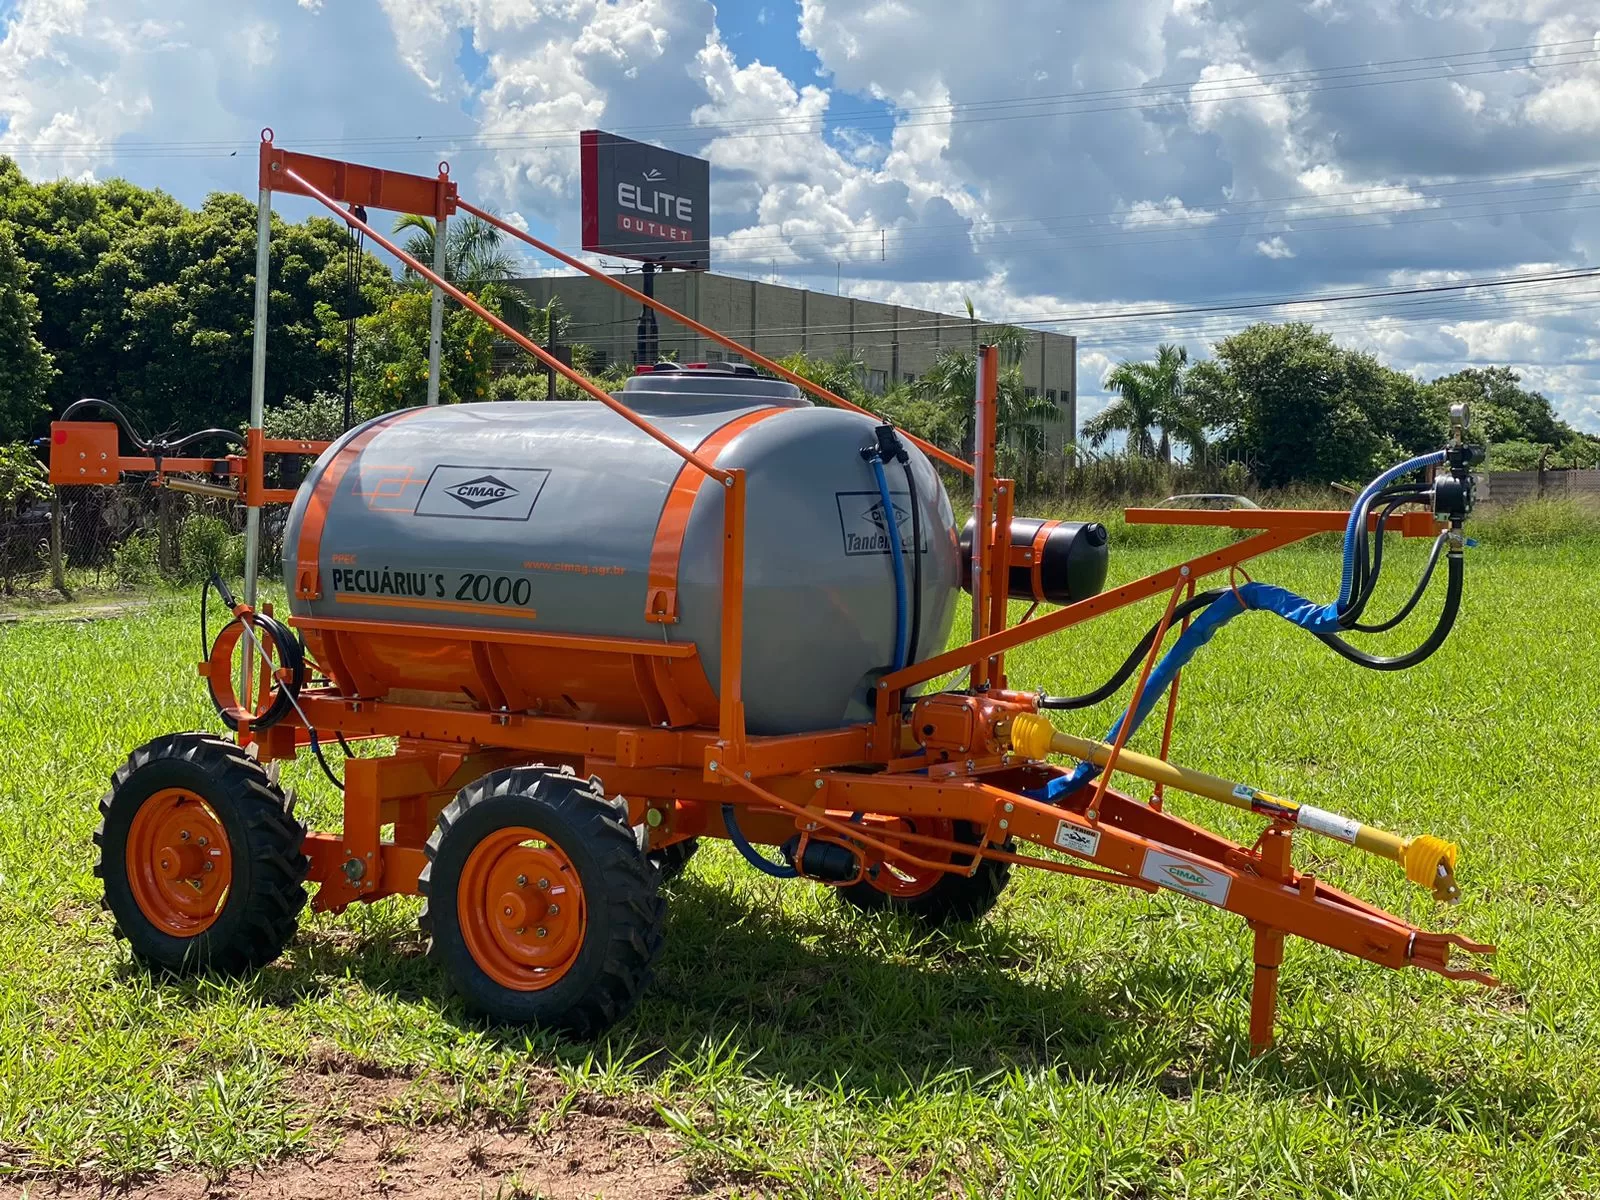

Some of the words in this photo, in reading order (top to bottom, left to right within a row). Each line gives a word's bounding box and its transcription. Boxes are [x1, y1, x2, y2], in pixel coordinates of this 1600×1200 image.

[618, 182, 692, 222] ELITE
[623, 217, 688, 241] OUTLET
[456, 485, 506, 498] CIMAG
[523, 560, 625, 576] www.cimag.agr.br
[455, 573, 533, 606] 2000
[1168, 866, 1205, 884] CIMAG
